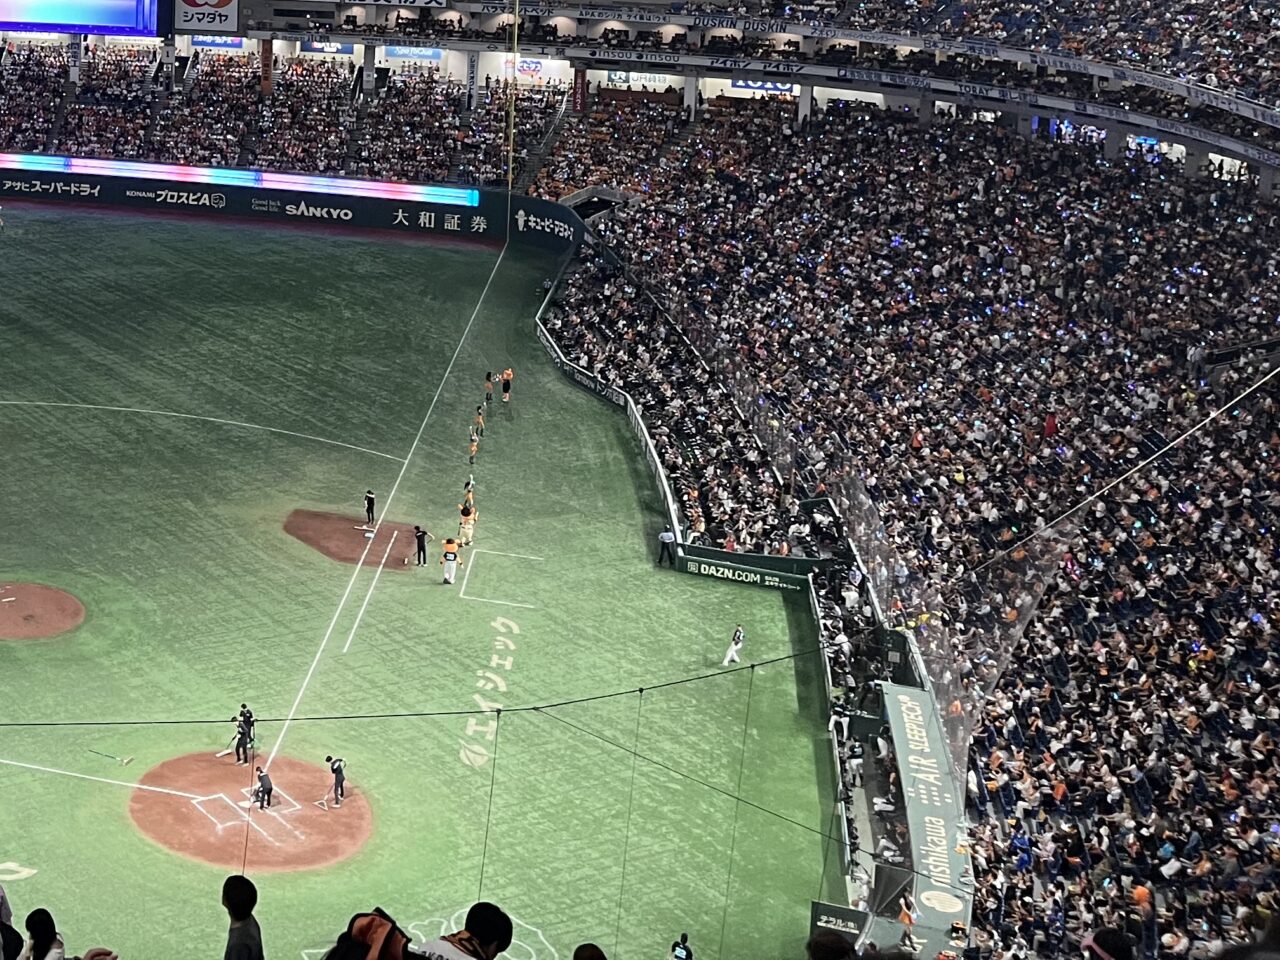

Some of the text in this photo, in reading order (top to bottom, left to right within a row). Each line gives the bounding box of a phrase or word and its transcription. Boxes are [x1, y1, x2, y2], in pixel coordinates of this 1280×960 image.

[182, 9, 230, 25] シマダヤ
[693, 16, 788, 34] DUSKIN DUSKIN
[156, 189, 211, 207] プロスピA
[285, 200, 353, 220] SANKYO
[391, 208, 488, 233] 大和証券
[700, 563, 761, 584] DAZN.COM
[922, 815, 951, 890] nishikawa
